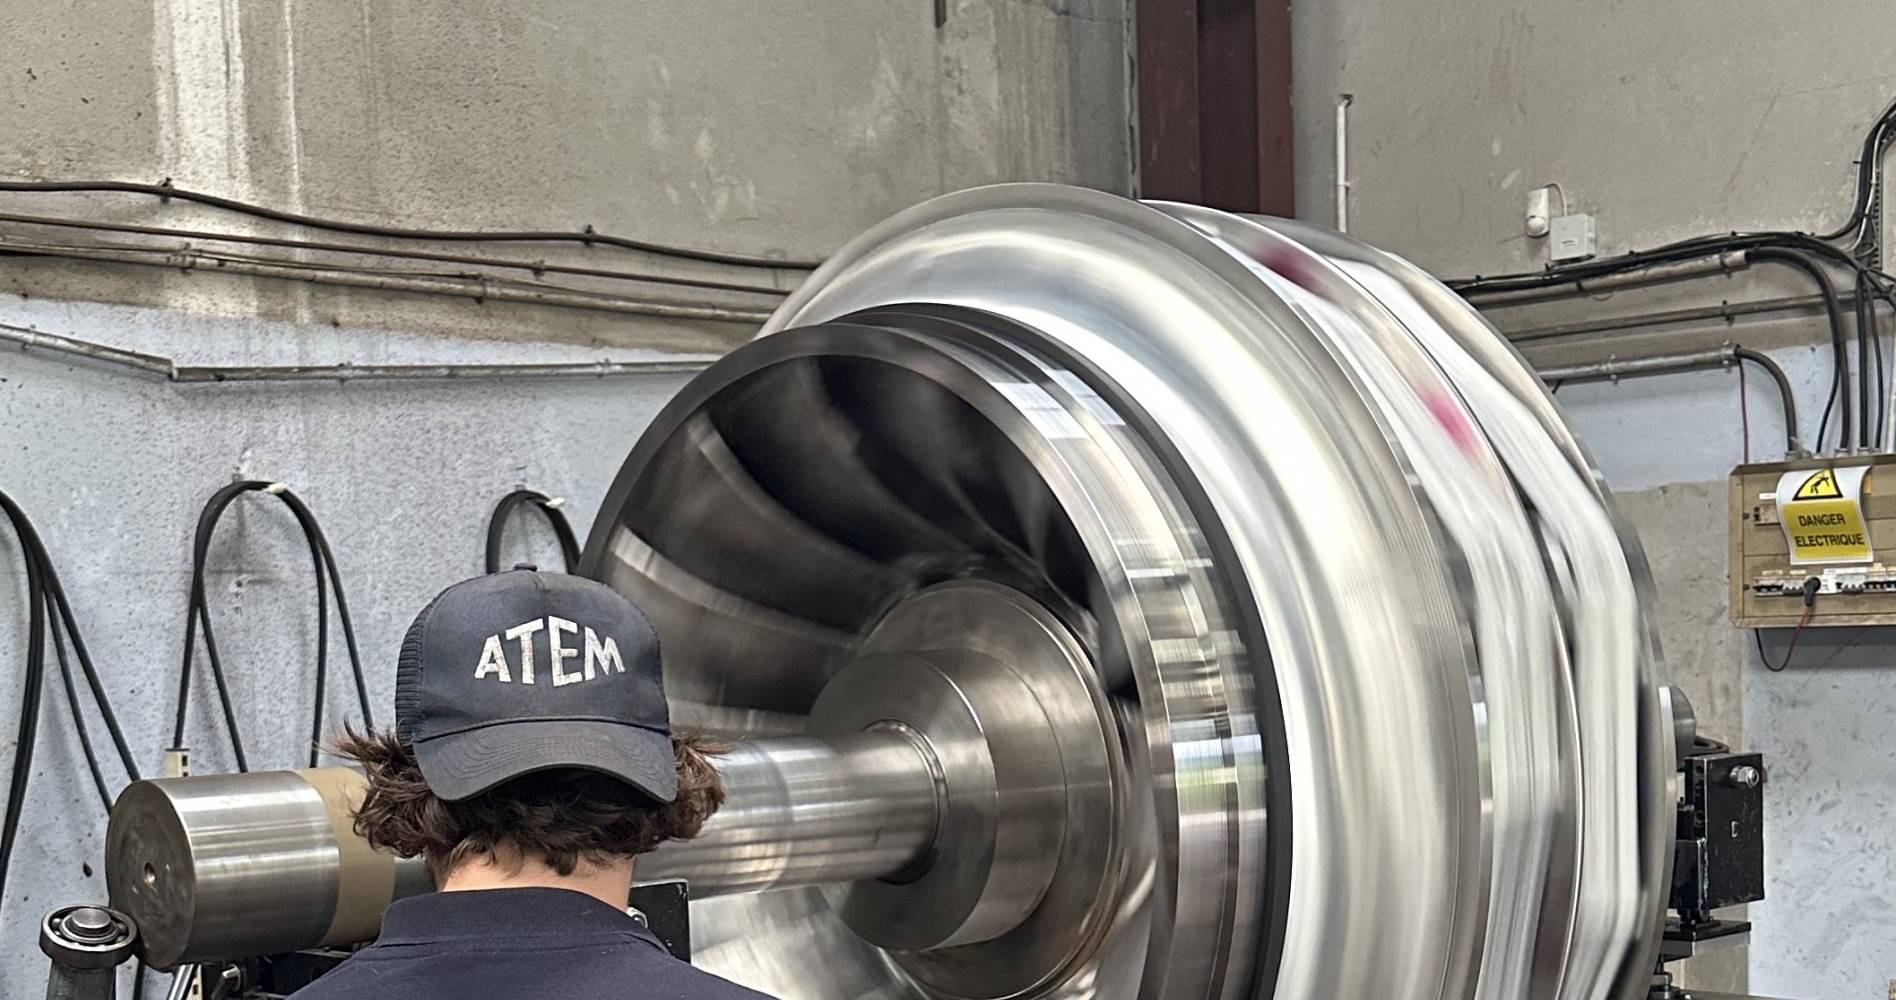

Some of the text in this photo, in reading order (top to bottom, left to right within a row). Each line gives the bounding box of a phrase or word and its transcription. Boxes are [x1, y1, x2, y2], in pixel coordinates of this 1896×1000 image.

[1798, 513, 1846, 527] DANGER
[1794, 533, 1864, 548] ELECTRIQUE
[474, 615, 625, 687] ATEM
